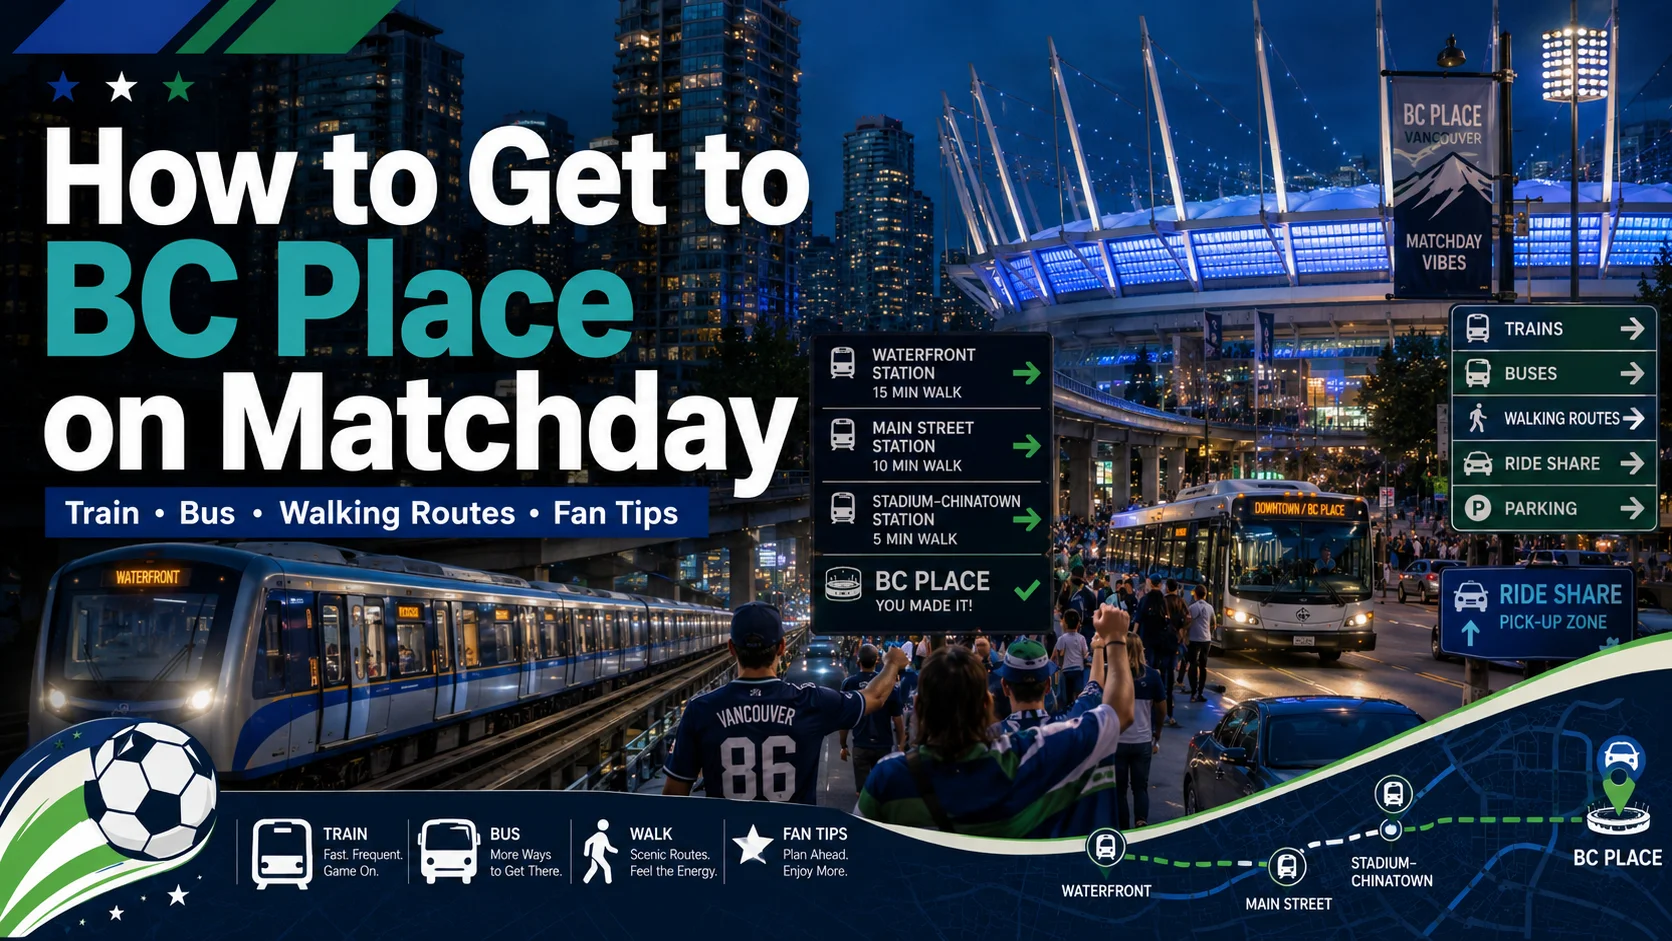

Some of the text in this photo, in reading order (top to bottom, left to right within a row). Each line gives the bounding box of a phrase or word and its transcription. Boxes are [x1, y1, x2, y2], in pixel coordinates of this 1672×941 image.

[1404, 104, 1481, 126] BC PLACE
[1404, 131, 1482, 145] VANCOUVER
[1406, 233, 1483, 250] MATCHDAY
[1422, 254, 1467, 271] VIBES
[1504, 321, 1563, 336] TRAINS
[872, 347, 977, 362] WATERFRONT
[872, 366, 935, 380] STATION
[1505, 366, 1558, 381] BUSES
[873, 385, 962, 399] 15 MIN WALK
[1504, 411, 1621, 426] WALKING ROUTES
[872, 420, 975, 435] MAIN STREET
[872, 439, 935, 453] STATION
[872, 459, 962, 472] 10 MIN WALK
[1505, 456, 1601, 471] RIDE SHARE
[1320, 503, 1346, 517] PLACE
[1505, 501, 1577, 516] PARKING
[872, 512, 935, 526] STATION
[873, 532, 958, 546] 5 MIN WALK
[115, 569, 181, 585] WATERFRONT
[876, 571, 989, 591] BC PLACE
[1500, 584, 1621, 604] RIDE SHARE
[875, 599, 973, 612] YOU MADE IT!
[1499, 614, 1607, 630] PICK-UP ZONE
[716, 704, 796, 728] VANCOUVER
[714, 735, 796, 801] 86
